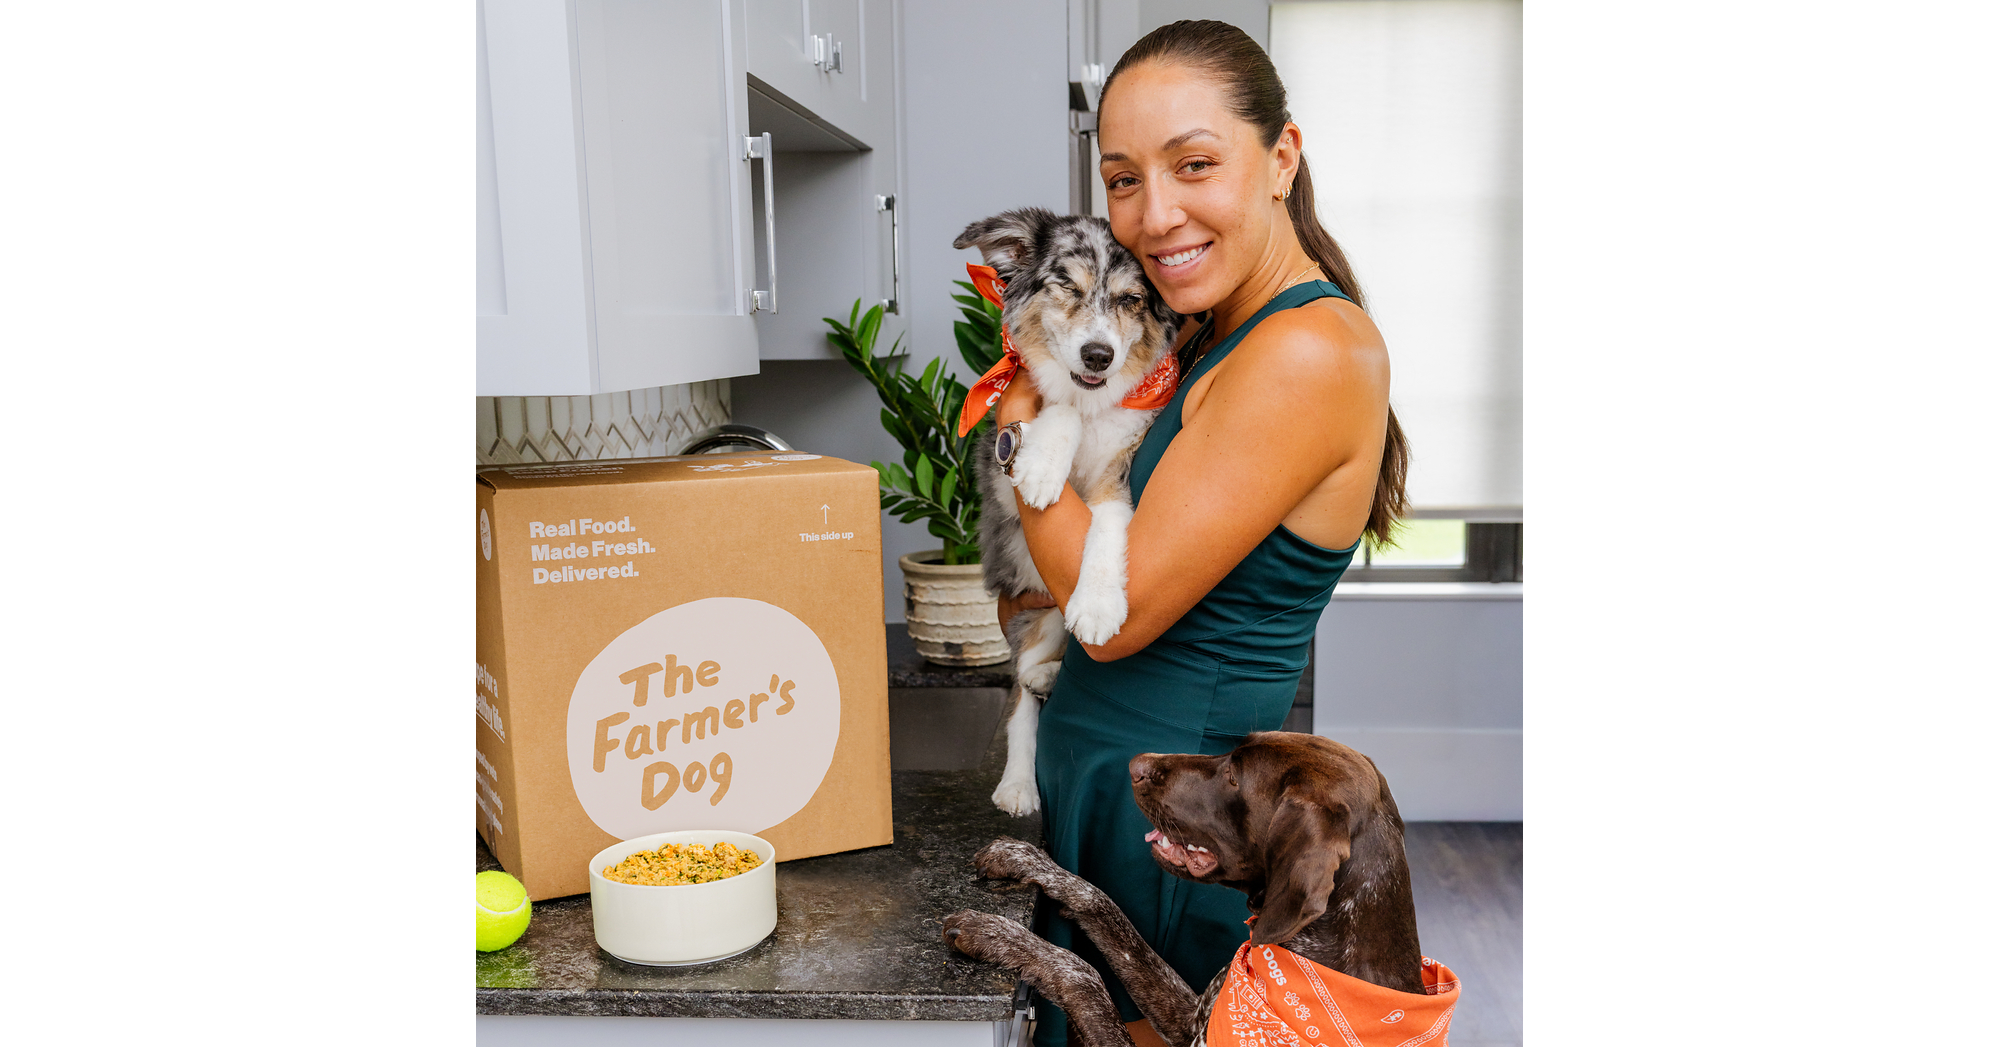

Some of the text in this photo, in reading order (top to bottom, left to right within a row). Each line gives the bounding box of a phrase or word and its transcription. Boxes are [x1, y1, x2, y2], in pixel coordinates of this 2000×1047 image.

[528, 515, 637, 539] Real Food.
[799, 531, 854, 542] This side up
[530, 537, 656, 562] Made Fresh.
[532, 561, 640, 585] Delivered.
[619, 654, 721, 707] The
[593, 674, 796, 773] Farmer's
[641, 752, 733, 811] Dog
[1262, 947, 1287, 986] Dogs
